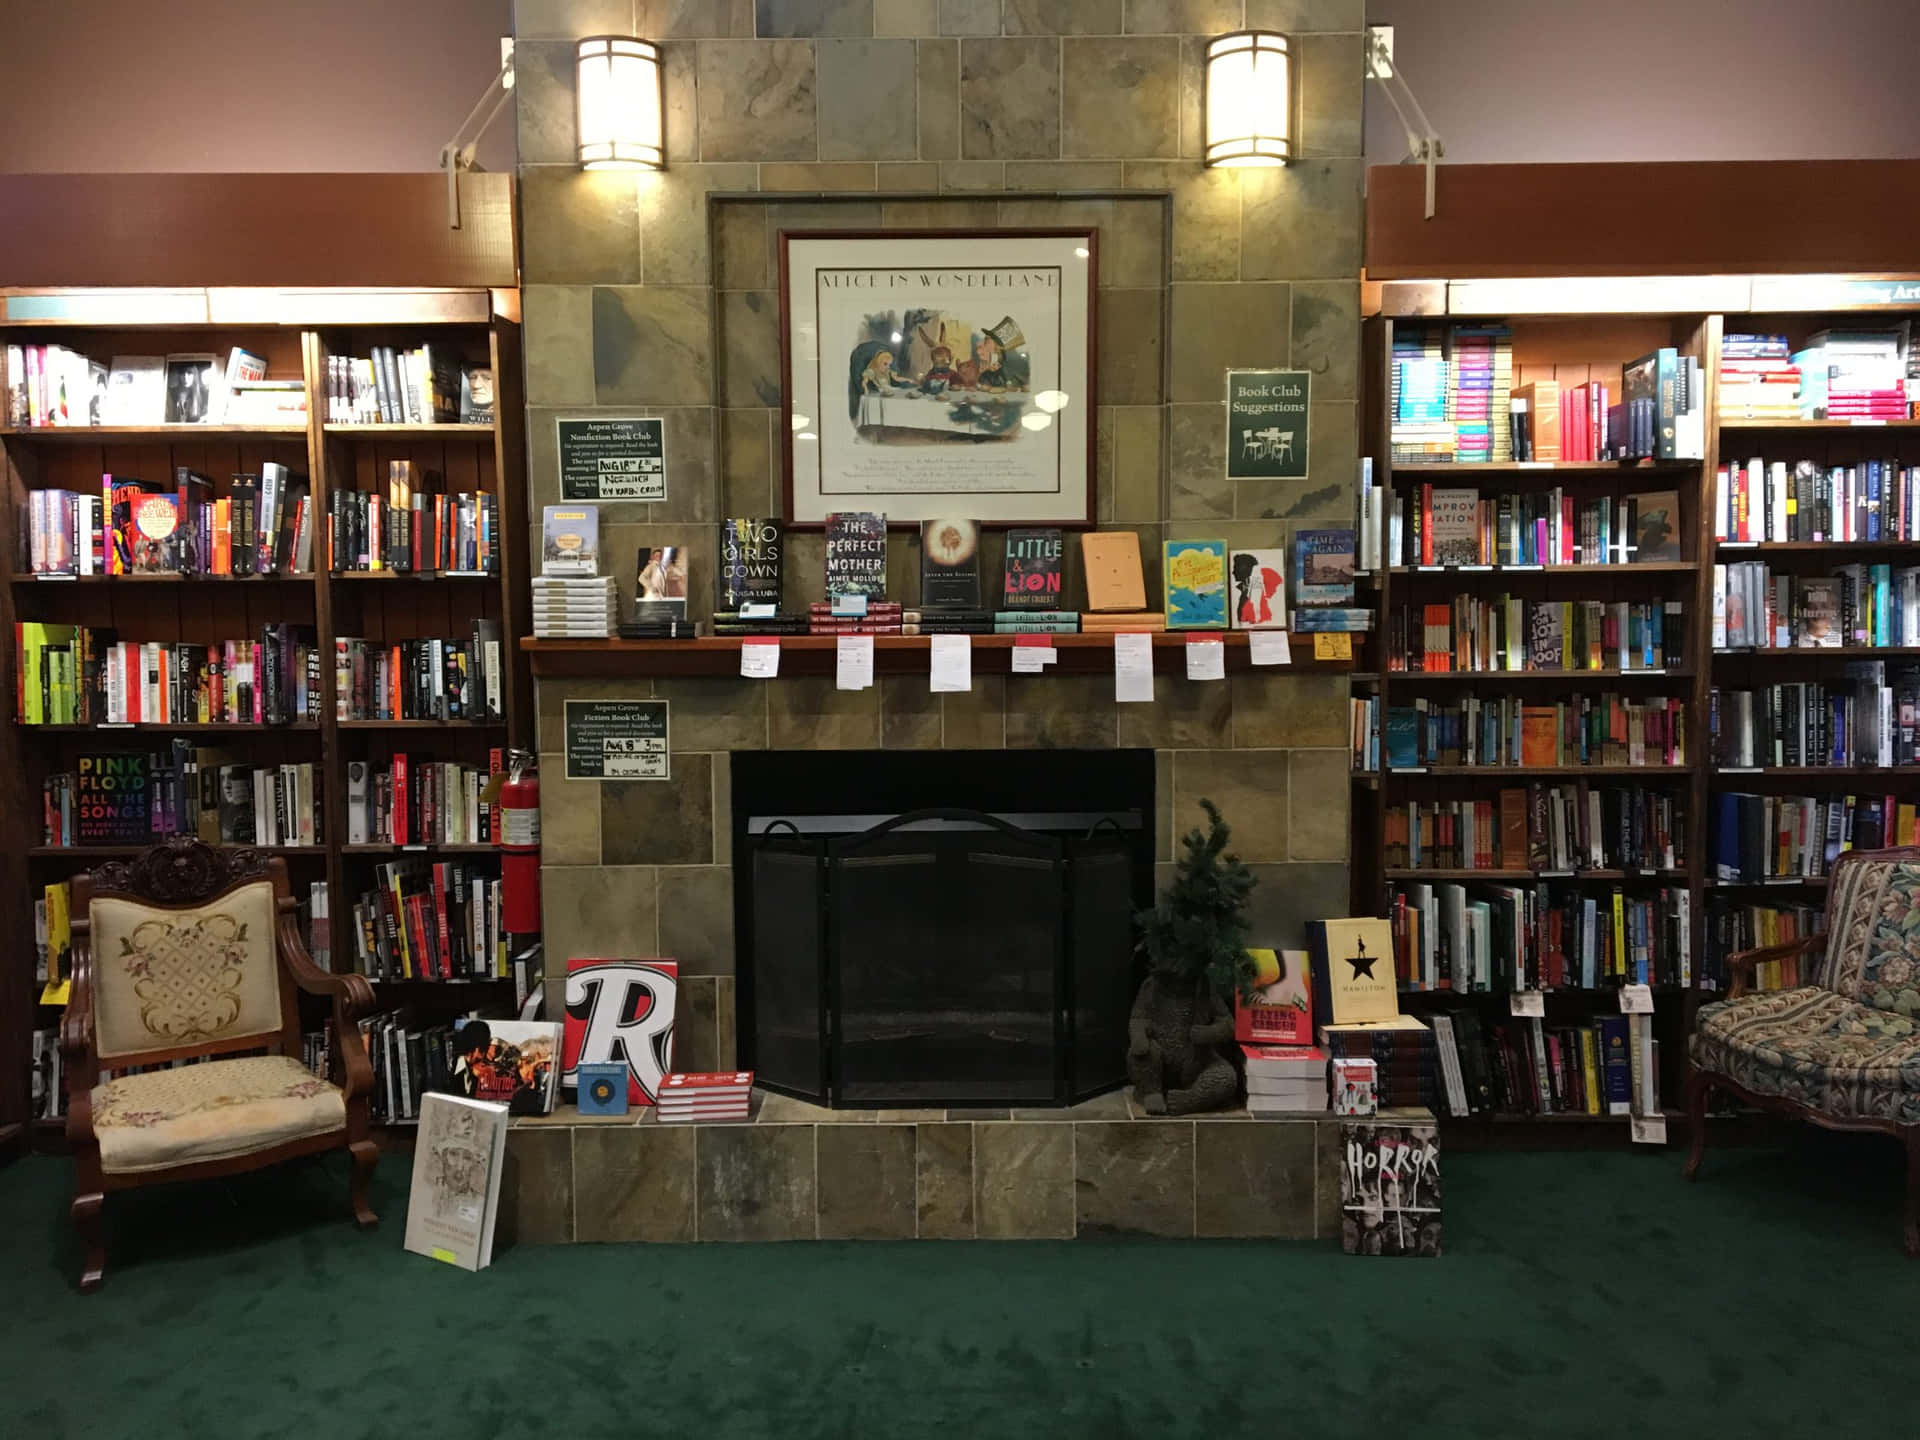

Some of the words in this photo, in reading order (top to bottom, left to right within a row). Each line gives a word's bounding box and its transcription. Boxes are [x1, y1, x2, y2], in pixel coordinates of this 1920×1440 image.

[823, 273, 876, 288] ALICE
[889, 274, 908, 288] IN
[919, 272, 1057, 288] WONDERLAND
[1238, 384, 1269, 397] Book
[1271, 384, 1301, 397] Club
[1232, 401, 1305, 415] Suggestions
[587, 424, 611, 432] Aspen
[612, 423, 633, 431] Grove
[570, 433, 611, 441] Nonfiction
[612, 433, 632, 441] Book
[633, 431, 652, 440] Club
[1432, 503, 1476, 511] MPROV
[1432, 514, 1475, 522] ATION
[843, 521, 867, 534] THE
[725, 526, 778, 543] TWO
[1309, 535, 1334, 545] TIME
[828, 540, 882, 552] PERFECT
[1006, 539, 1062, 559] LITTLE
[1311, 545, 1345, 553] AGAIN
[724, 546, 778, 561] GIRLS
[723, 564, 778, 578] DOWN
[828, 558, 882, 571] MOTHER
[1012, 559, 1024, 572] &
[1005, 572, 1061, 593] LION
[1536, 615, 1549, 624] ON
[181, 648, 189, 673] SLASH
[420, 643, 429, 671] Miles
[594, 704, 616, 712] Aspen
[612, 713, 631, 721] Book
[632, 713, 650, 721] Club
[79, 758, 143, 774] PINK
[79, 777, 144, 790] FLOYD
[80, 794, 108, 804] ALL
[116, 794, 145, 804] THE
[80, 806, 145, 818] SONGS
[364, 920, 375, 953] RAW
[1342, 984, 1387, 993] HAMILTON
